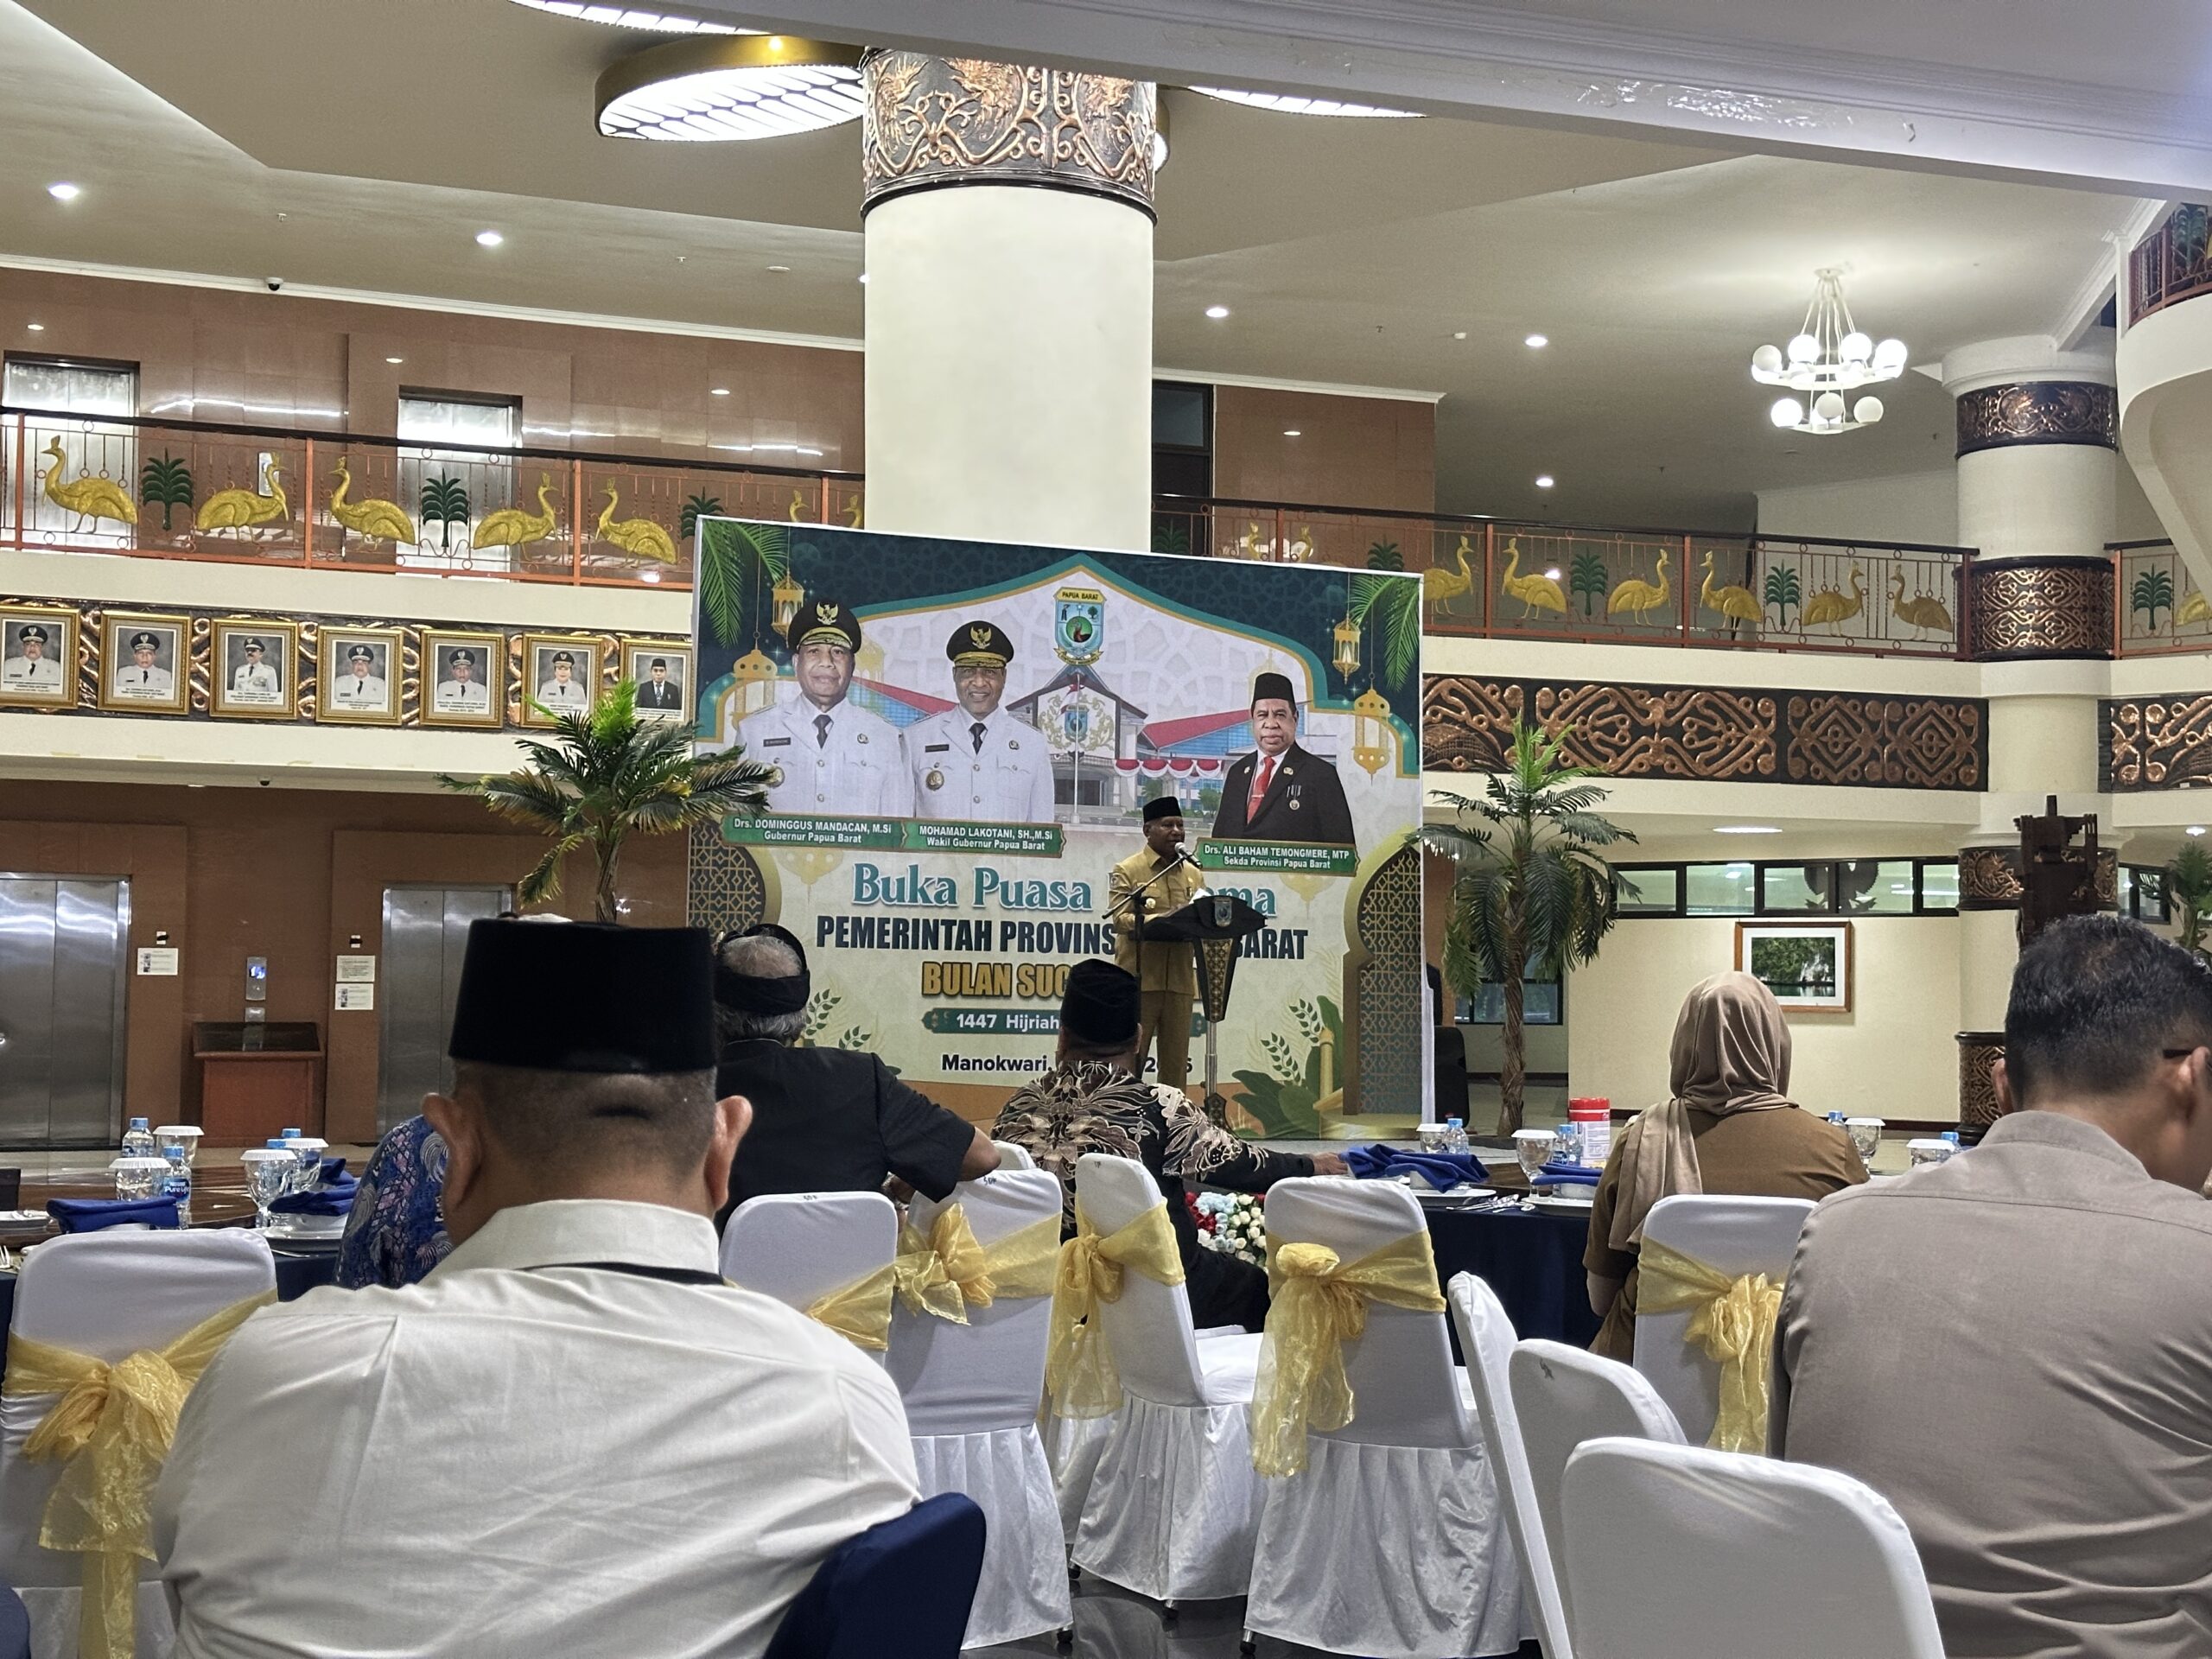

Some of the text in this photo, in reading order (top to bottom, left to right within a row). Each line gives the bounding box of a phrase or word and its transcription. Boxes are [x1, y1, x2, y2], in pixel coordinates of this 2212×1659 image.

[734, 818, 892, 834] Drs. DOMINGGUS MANDACAN, M.Si
[919, 825, 965, 836] MOHAMAD
[969, 828, 1015, 840] LAKOTANI,
[764, 830, 862, 844] Gubernur Papua Barat
[926, 837, 1046, 851] Wakil Gubernur Papua Barat
[1205, 844, 1350, 860] Drs. ALI BAHAM TEMONGMERE, MTP
[1224, 856, 1331, 869] Sekda Provinsi Papua Barat
[852, 862, 1093, 912] Buka Puasa
[816, 915, 1308, 960] PEMERINTAH PROVINS ARAT
[922, 961, 1071, 999] BULAN SUC
[956, 1014, 1060, 1033] 1447 Hijriah
